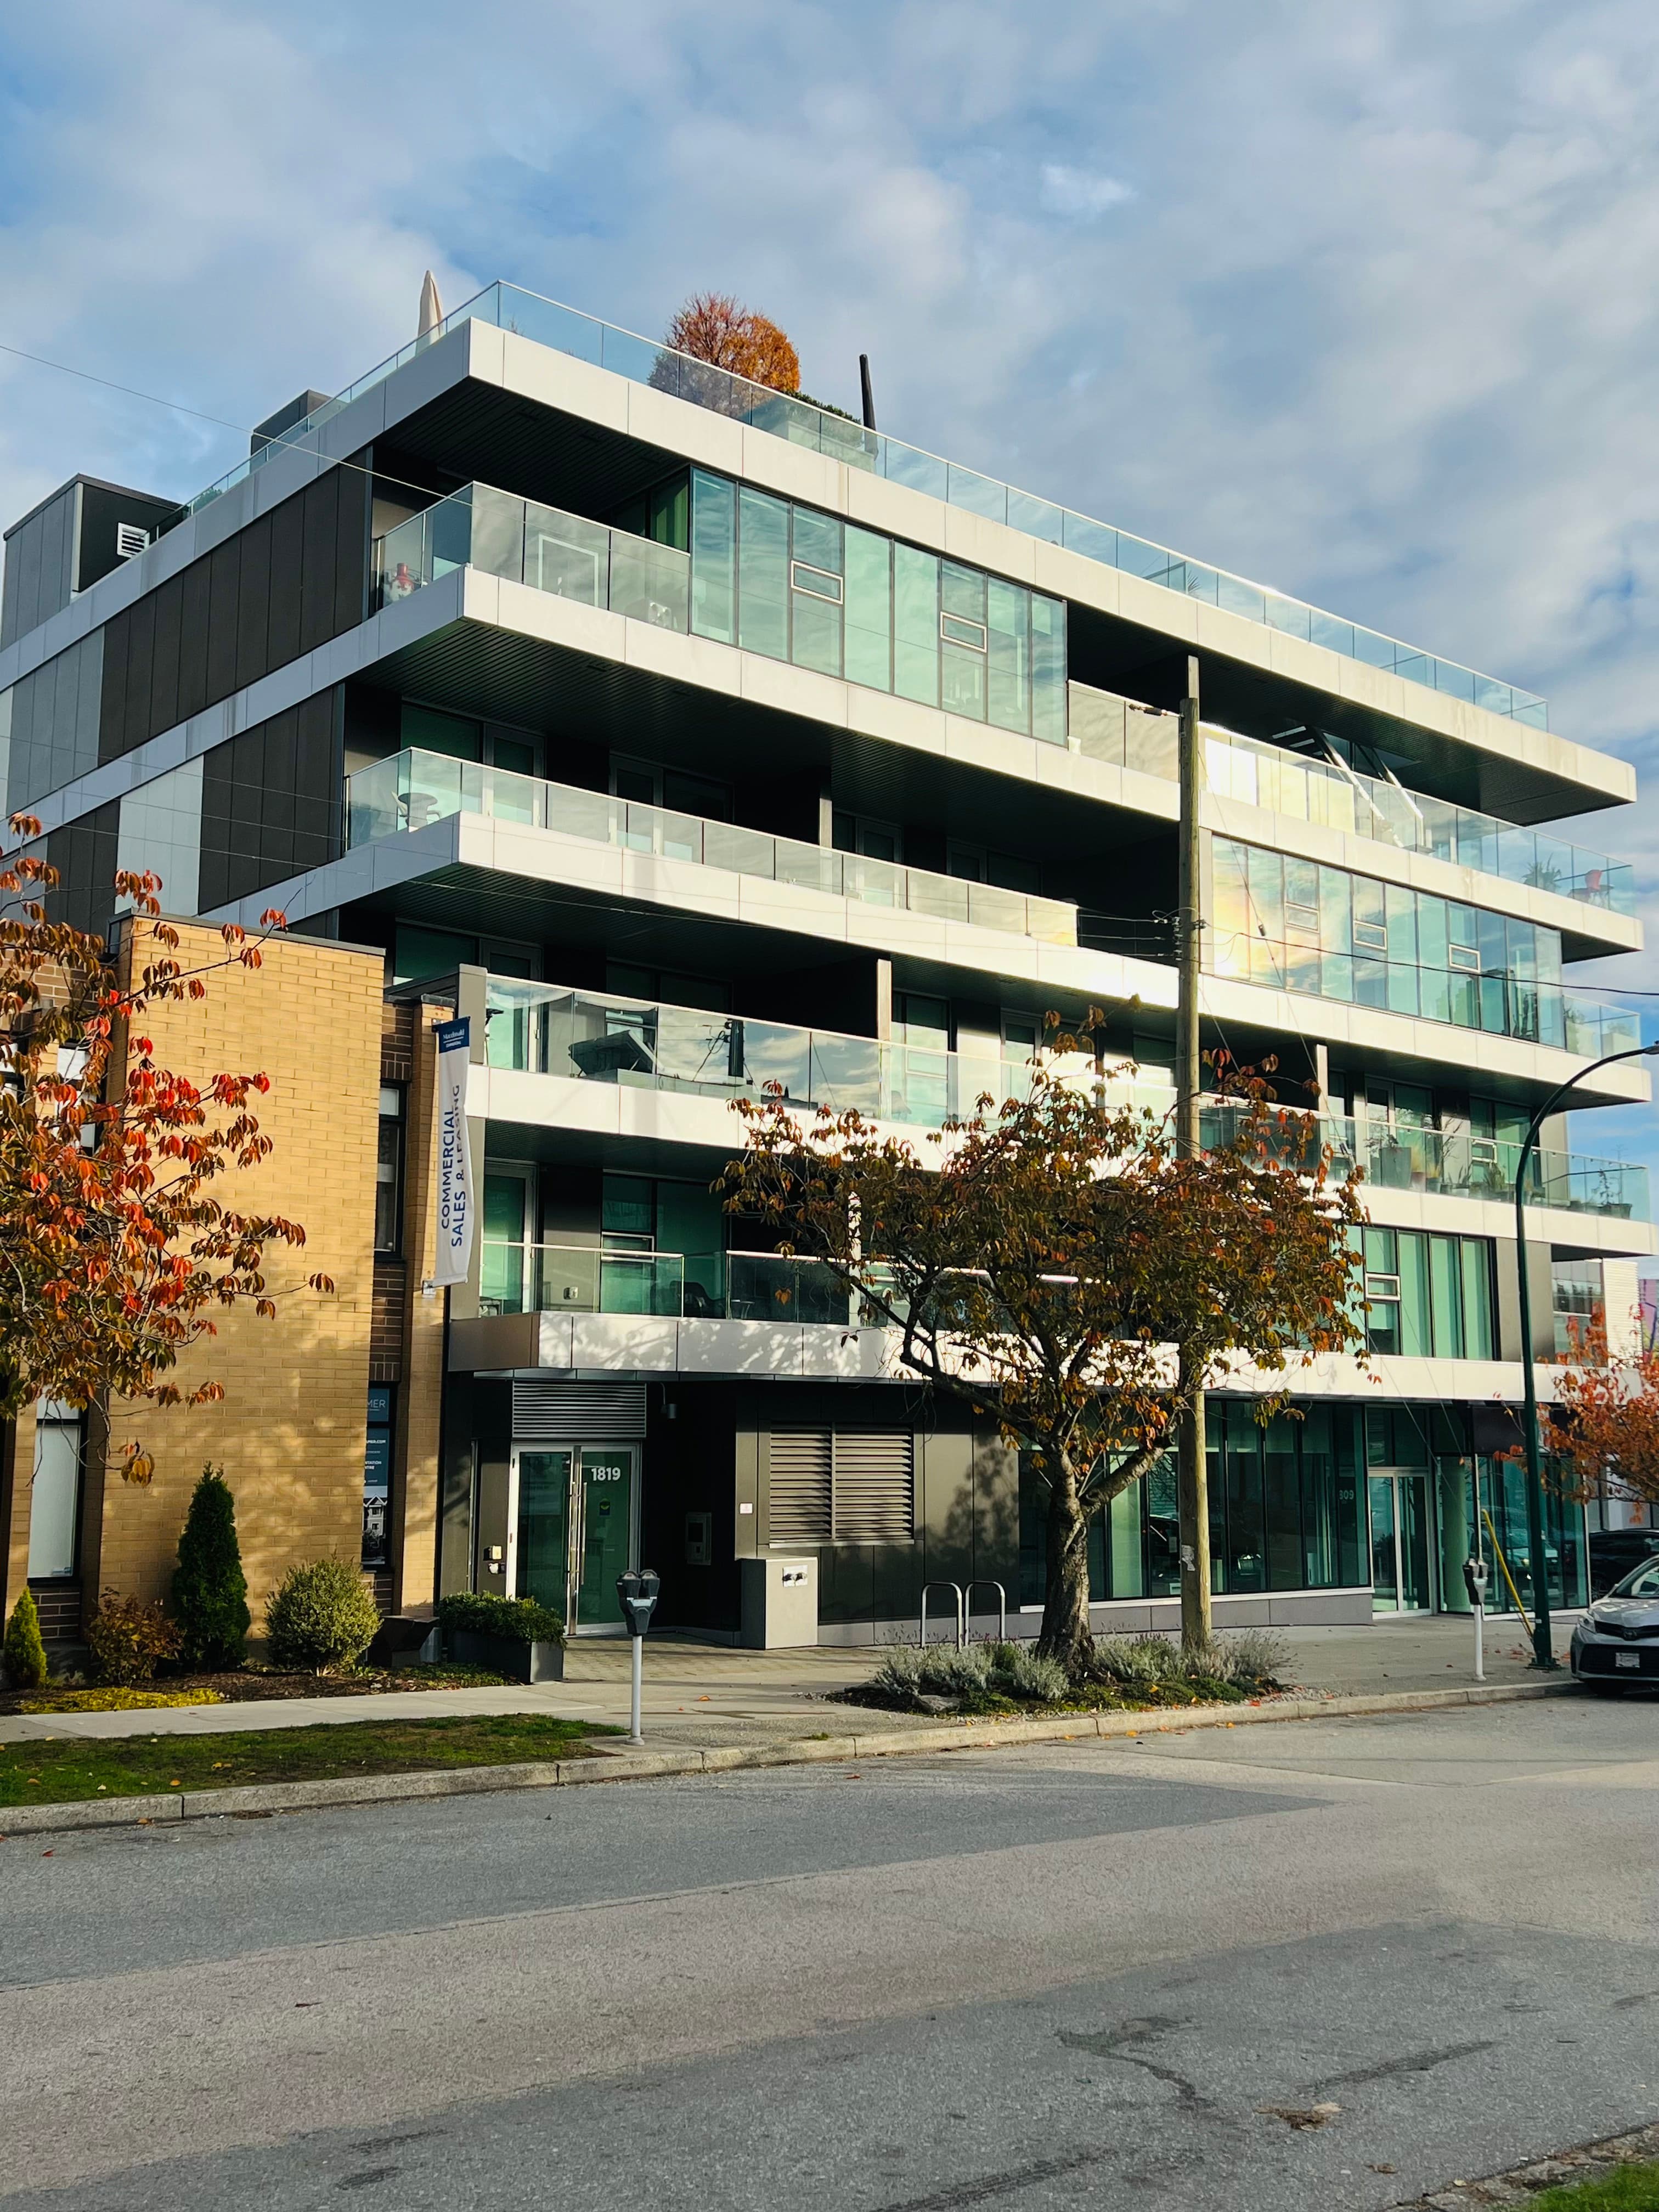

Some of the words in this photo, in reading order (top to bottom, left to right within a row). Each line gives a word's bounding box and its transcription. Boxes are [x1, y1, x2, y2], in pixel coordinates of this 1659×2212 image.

[441, 1104, 454, 1229] COMMERCIAL
[456, 1169, 464, 1181] &
[452, 1190, 466, 1247] SALES
[591, 1466, 620, 1481] 1819
